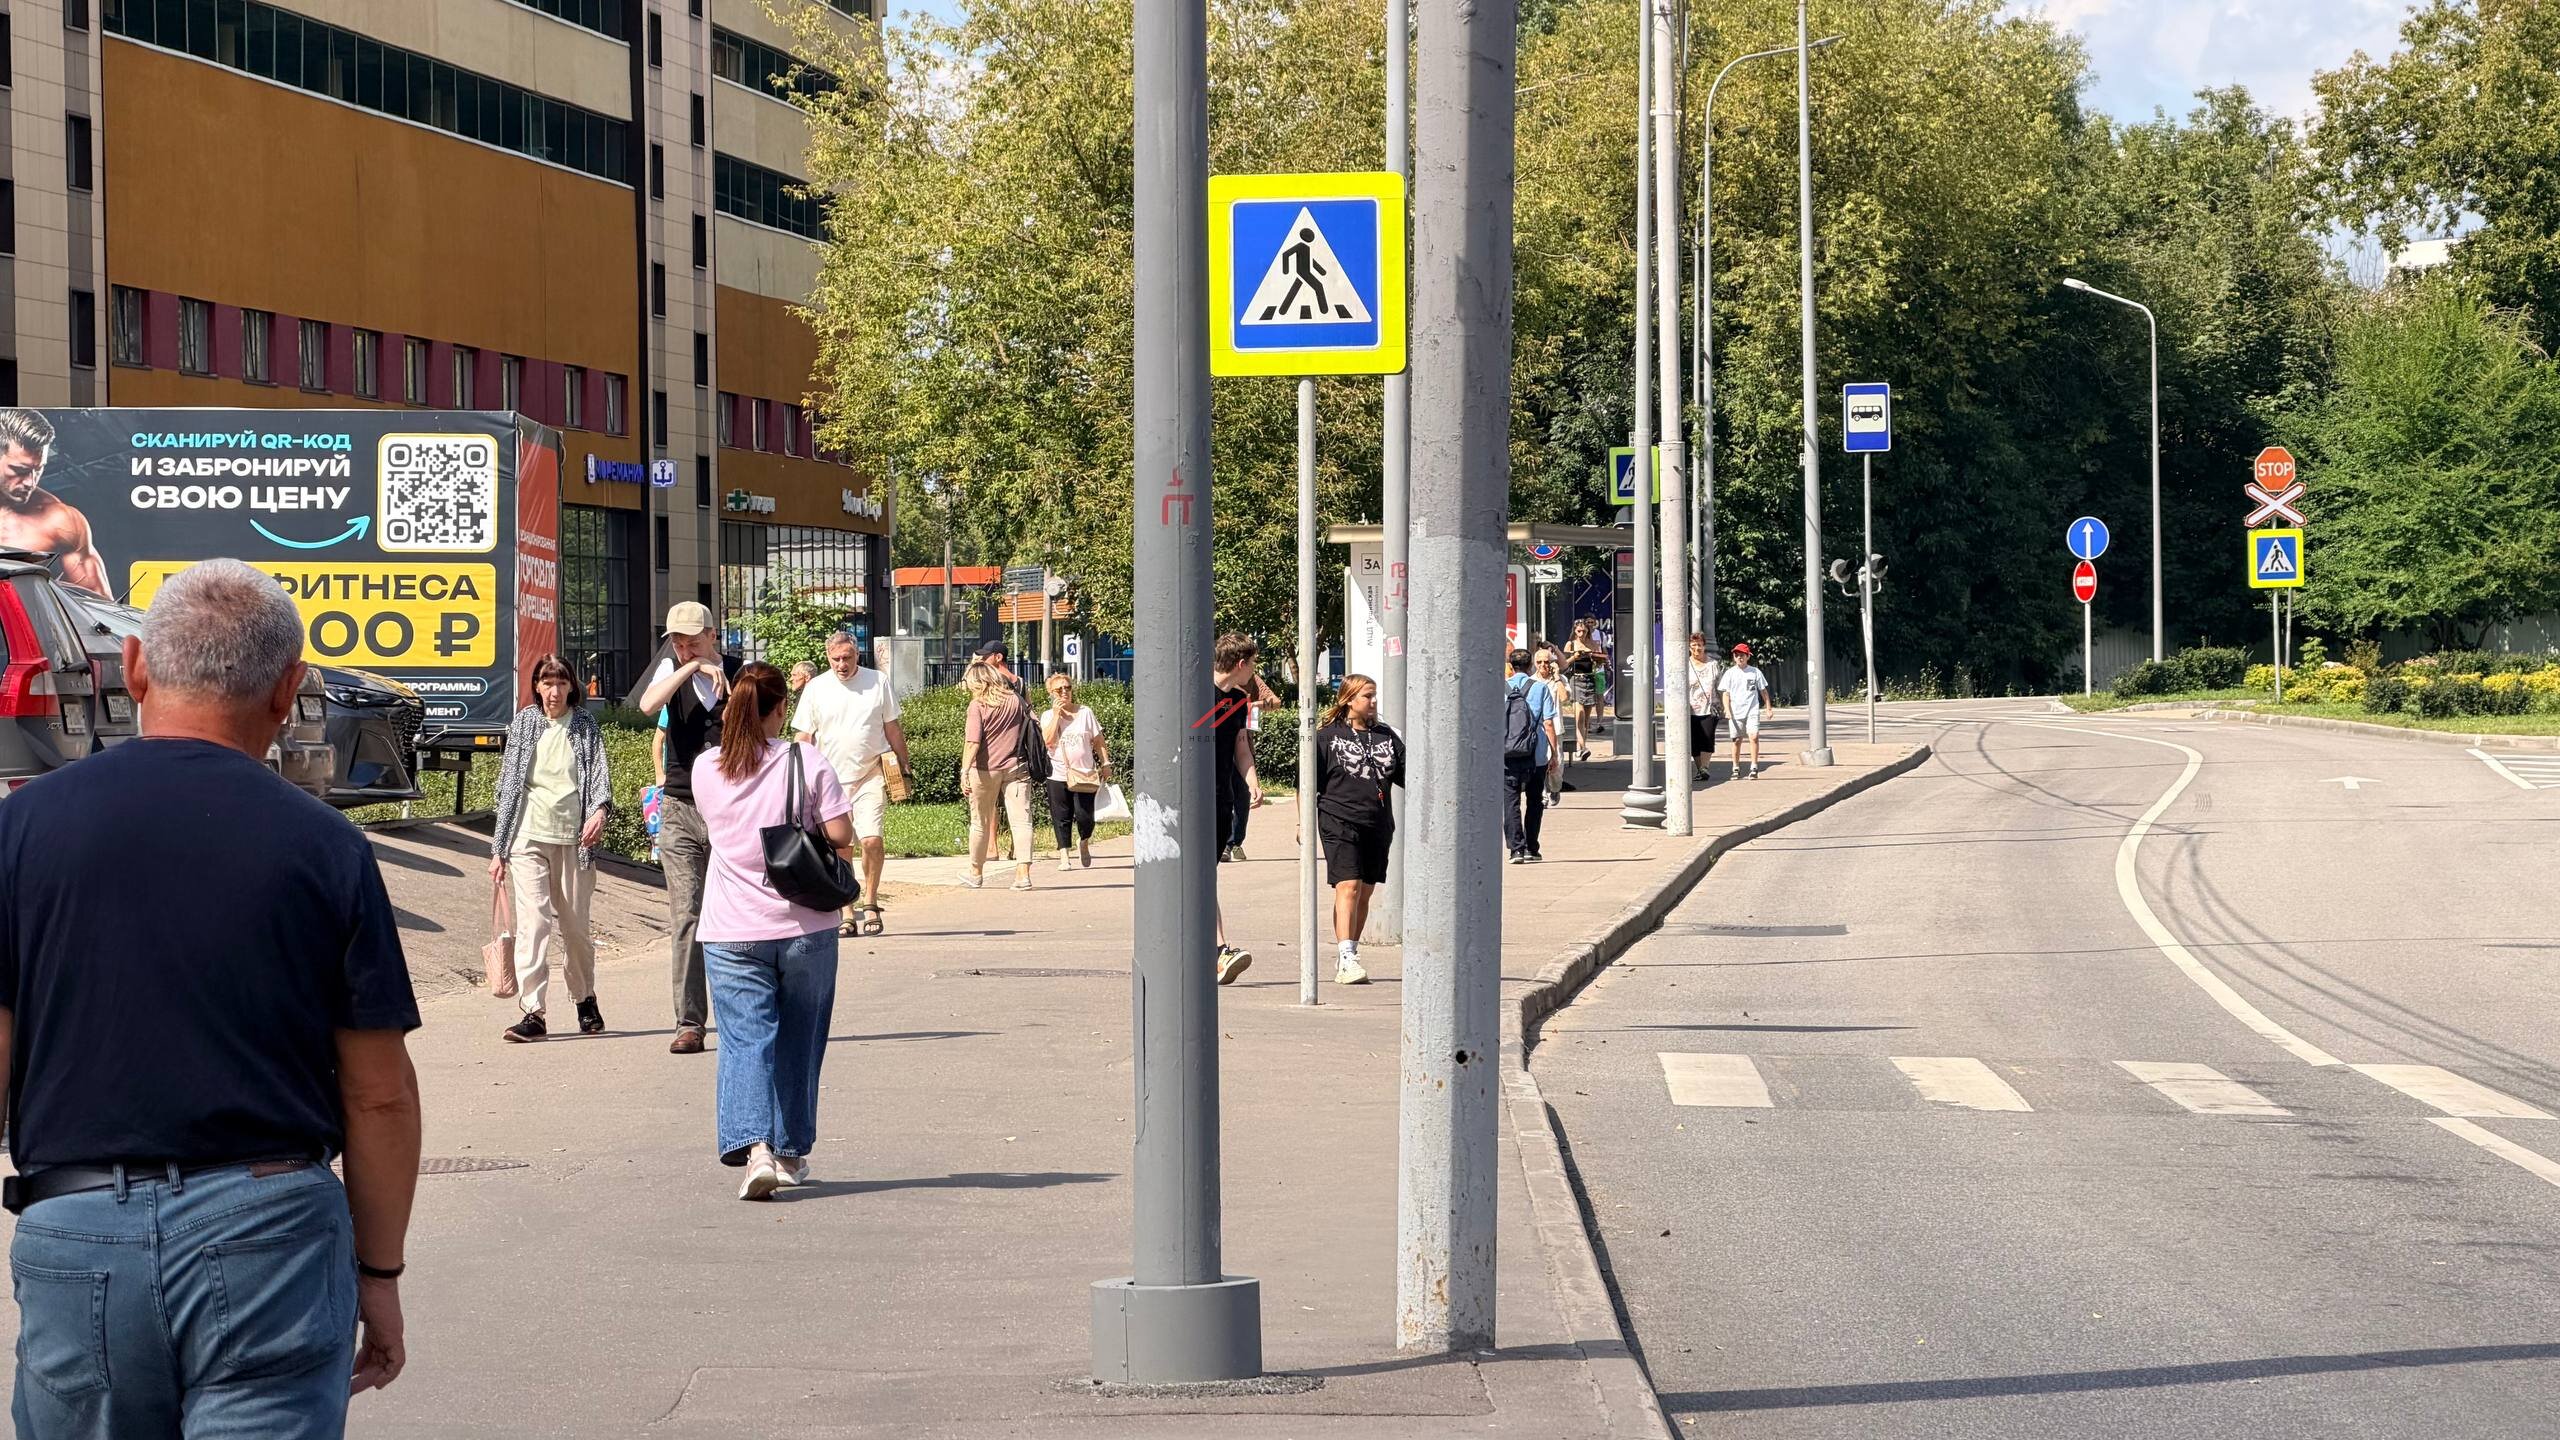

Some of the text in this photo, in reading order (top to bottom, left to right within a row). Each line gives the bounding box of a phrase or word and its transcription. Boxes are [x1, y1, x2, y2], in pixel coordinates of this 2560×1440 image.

[131, 430, 352, 451] СКАНИРУЙ QR-КОД
[131, 454, 351, 477] И ЗАБРОНИРУЙ
[2257, 462, 2293, 477] STOP
[130, 485, 351, 513] СВОЮ ЦЕНУ
